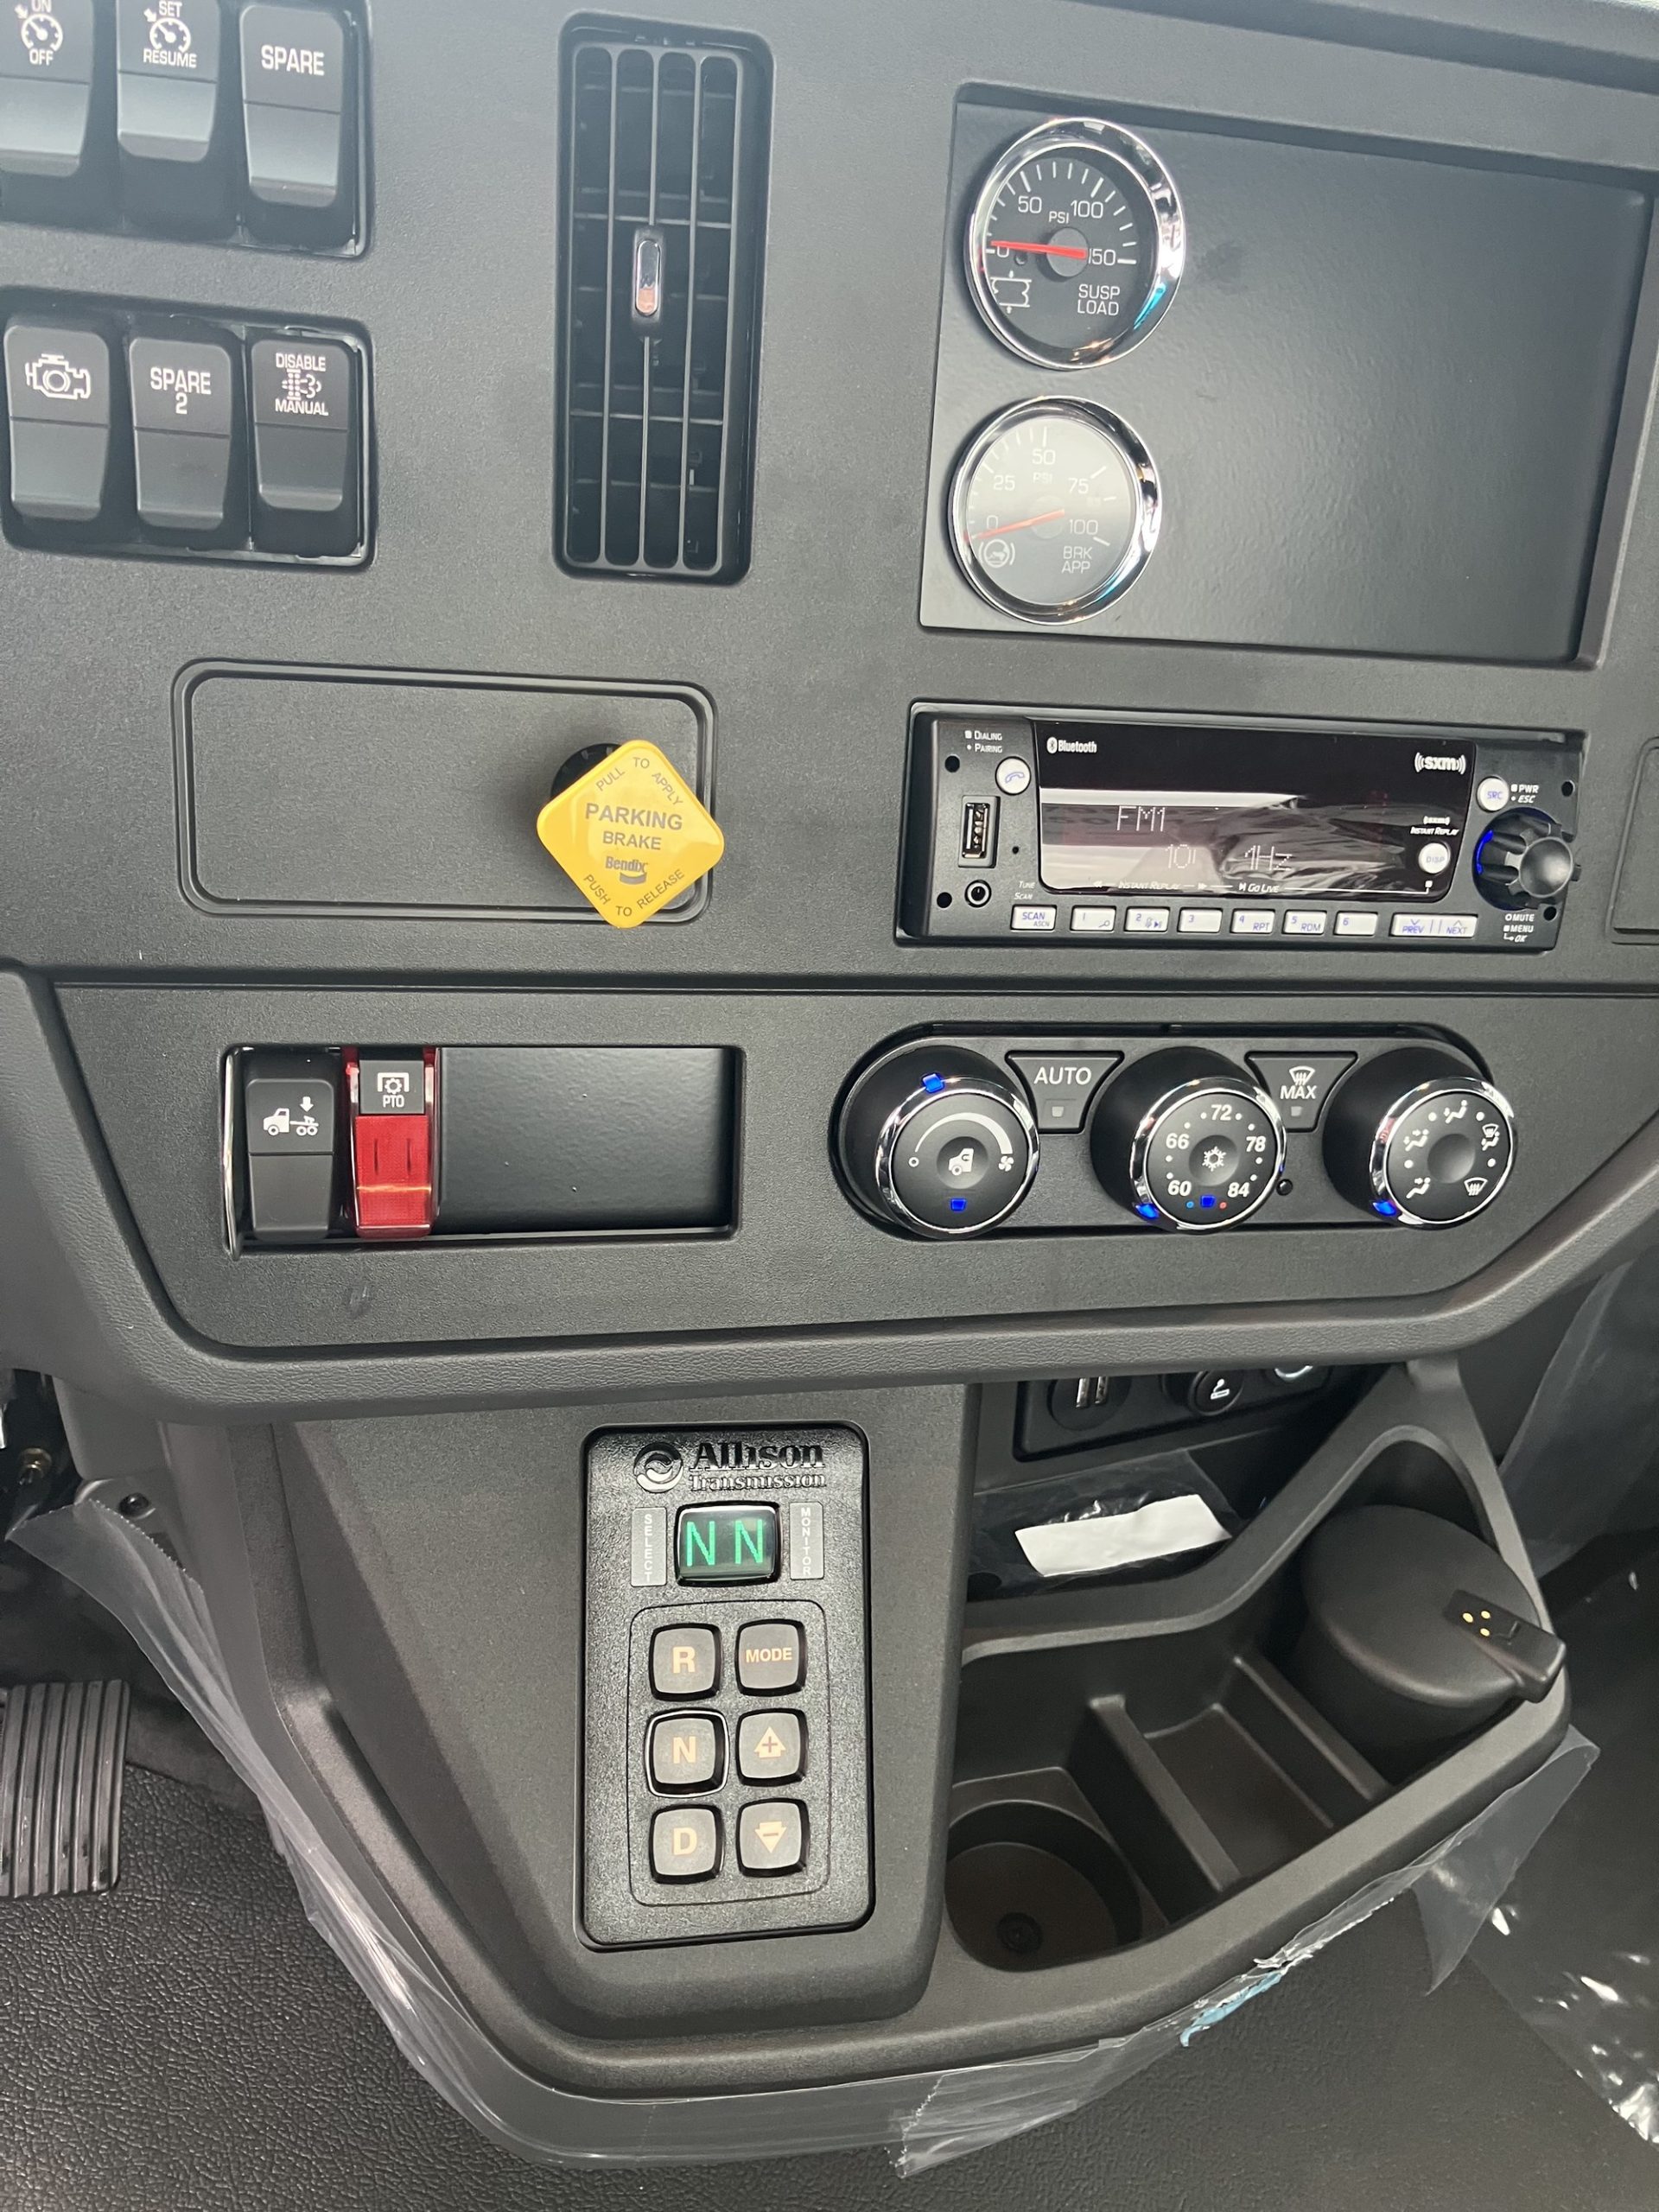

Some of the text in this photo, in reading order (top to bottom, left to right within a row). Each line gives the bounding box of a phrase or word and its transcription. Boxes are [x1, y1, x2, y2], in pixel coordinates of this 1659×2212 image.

[31, 0, 52, 13] ON
[159, 1, 182, 17] SET
[29, 50, 54, 66] OFF
[143, 50, 198, 68] RESUME
[261, 45, 326, 76] SPARE
[1018, 196, 1042, 214] 50
[1071, 200, 1103, 219] 100
[1048, 211, 1070, 224] PSI
[1088, 248, 1116, 265] 150
[1078, 283, 1121, 300] SUSP
[1077, 300, 1119, 316] LOAD
[275, 353, 327, 372] DISABLE
[150, 367, 212, 395] SPARE
[175, 395, 188, 415] 2
[275, 398, 329, 416] MANUAL
[1032, 449, 1056, 466] 50
[993, 475, 1015, 491] 25
[1033, 473, 1053, 485] PSI
[1068, 478, 1090, 494] 75
[1069, 519, 1099, 535] 100
[1063, 545, 1092, 559] BRK
[1061, 561, 1091, 574] APP
[1058, 739, 1097, 753] Bluetooth
[595, 757, 683, 806] PULL TO APPLY
[1519, 785, 1540, 794] PWR
[1487, 791, 1503, 799] SRC
[1517, 795, 1536, 804] ESC
[585, 803, 683, 830] PARKING
[1116, 805, 1166, 832] FM1
[602, 830, 662, 850] BRAKE
[605, 855, 648, 874] Bendix
[583, 868, 684, 917] PUSH TO RELEASE
[1021, 912, 1046, 920] SCAN
[1135, 913, 1142, 923] 2
[1188, 914, 1196, 924] 3
[1292, 916, 1298, 925] 5
[1343, 917, 1349, 926] 6
[1512, 913, 1535, 923] MUTE
[1253, 922, 1270, 931] RPT
[1301, 923, 1321, 932] RDM
[1402, 925, 1424, 935] PREV
[1446, 926, 1468, 935] NEXT
[1510, 925, 1535, 933] MENU
[1515, 934, 1528, 943] OK
[1033, 1067, 1092, 1085] AUTO
[1280, 1085, 1318, 1099] MAX
[382, 1095, 405, 1109] PTO
[1211, 1104, 1232, 1121] 72
[1166, 1133, 1190, 1150] 66
[1245, 1136, 1267, 1153] 78
[1167, 1180, 1192, 1196] 60
[1227, 1182, 1250, 1198] 84
[689, 1441, 825, 1471] Allison
[690, 1472, 827, 1491] Transmission
[644, 1513, 653, 1585] SELECT
[686, 1519, 763, 1567] N N
[800, 1507, 811, 1577] MONITOR
[672, 1646, 696, 1674] R
[746, 1647, 793, 1663] MODE
[672, 1736, 696, 1764] N
[672, 1827, 698, 1856] D
